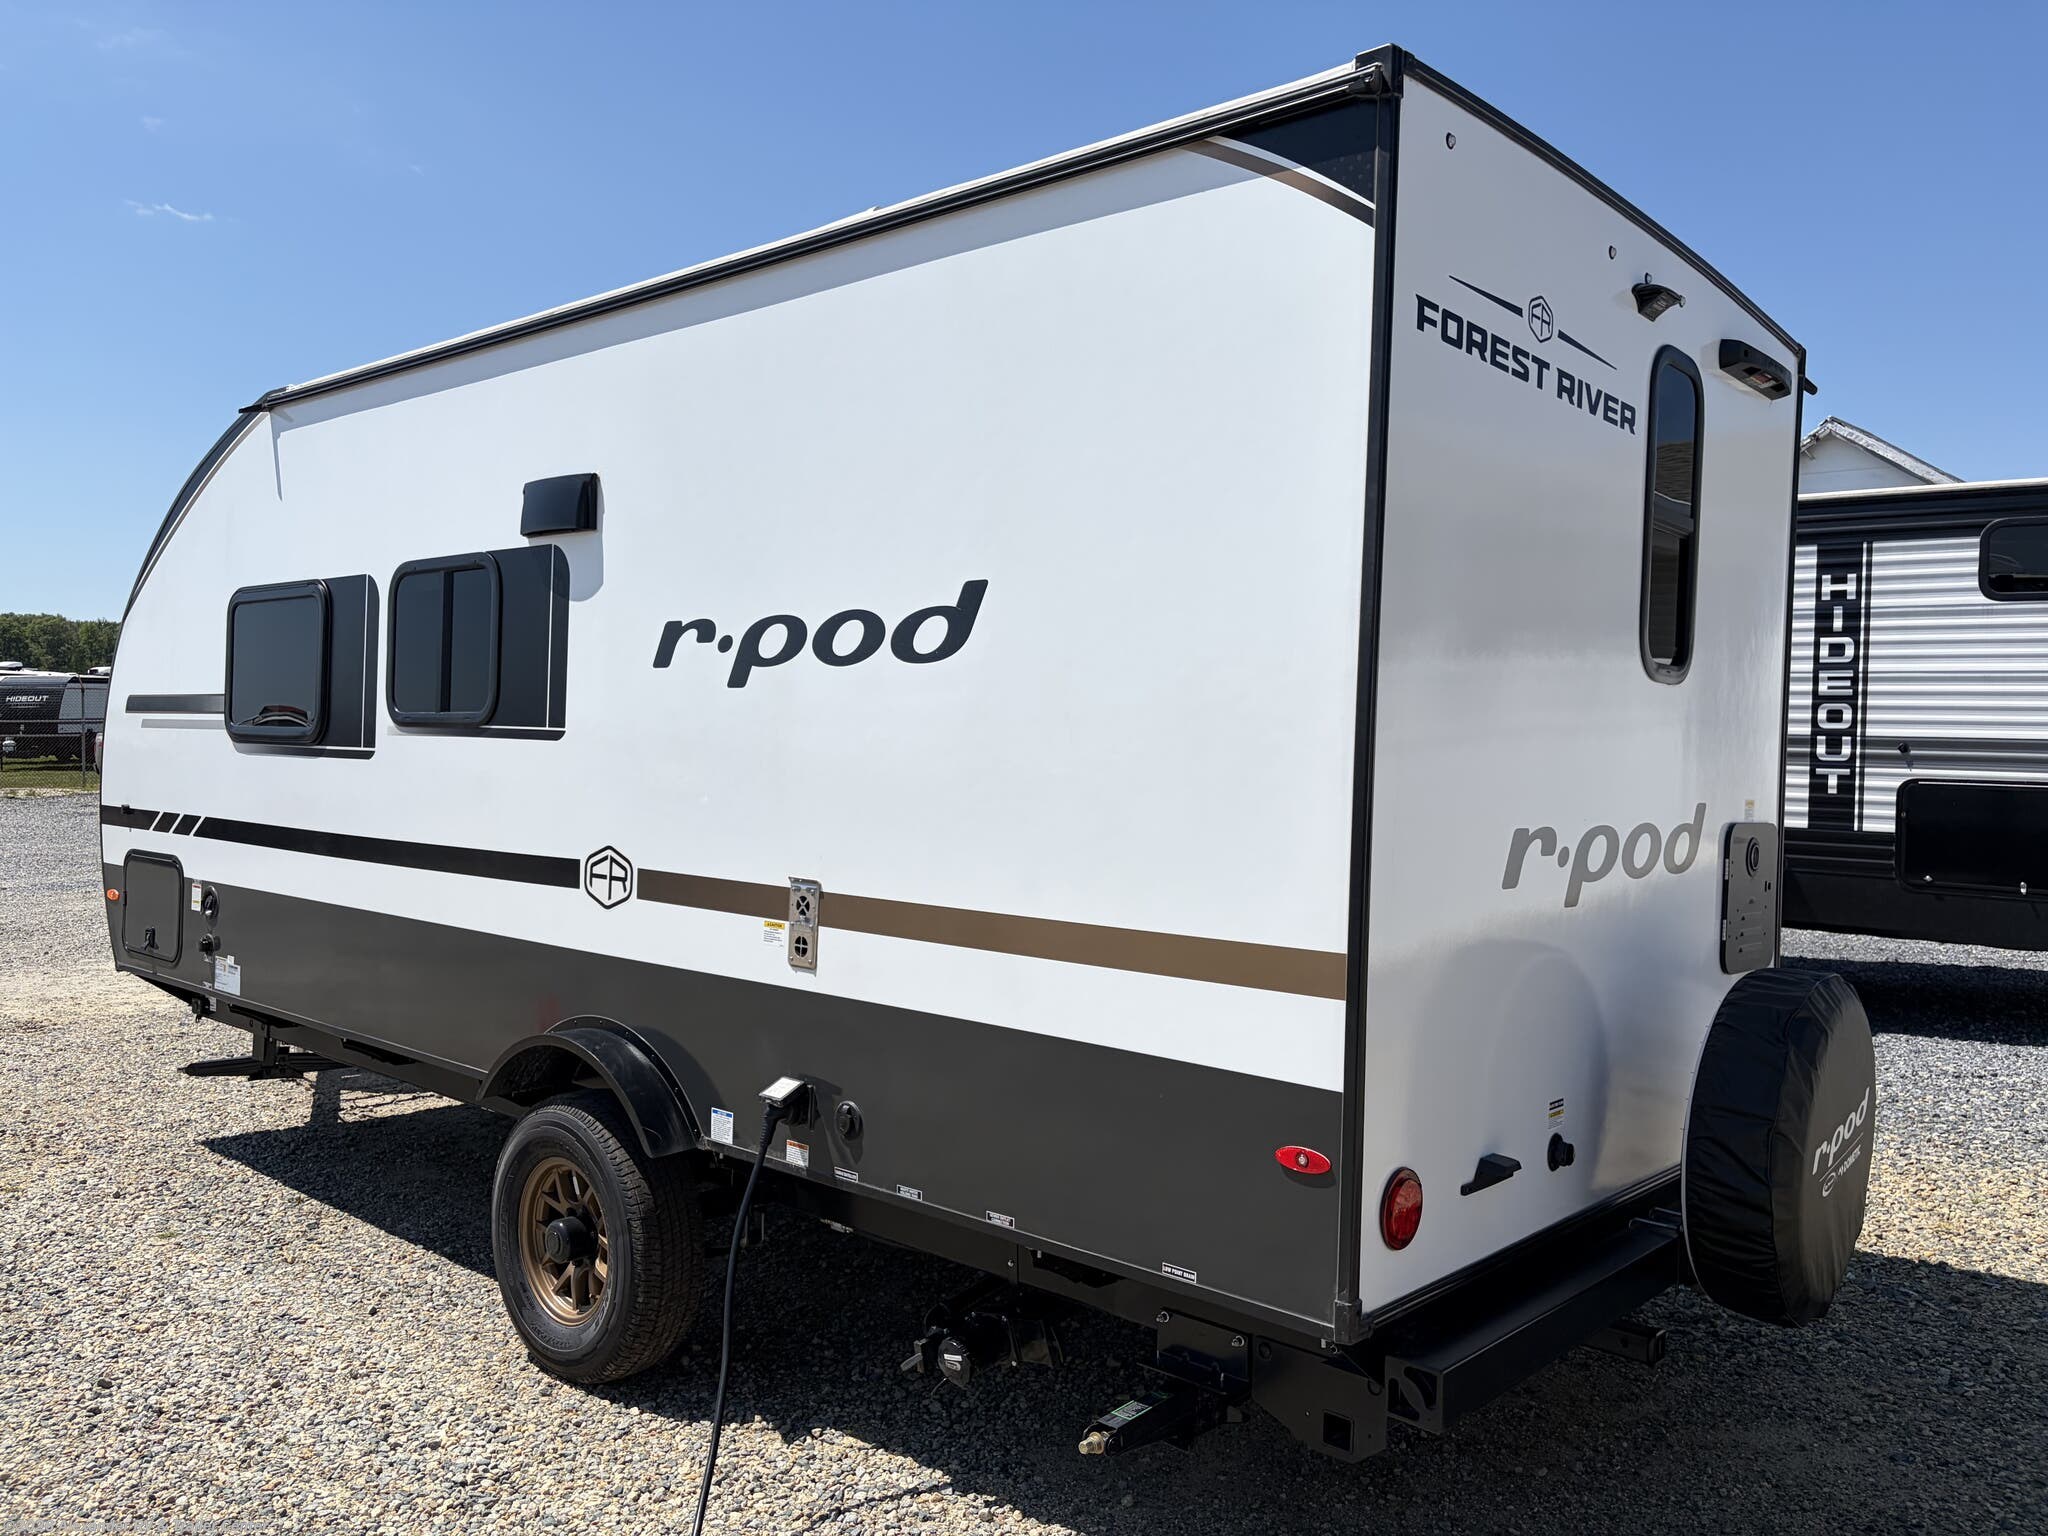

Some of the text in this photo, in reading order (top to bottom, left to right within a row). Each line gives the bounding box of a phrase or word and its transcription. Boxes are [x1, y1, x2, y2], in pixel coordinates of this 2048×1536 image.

[1415, 294, 1636, 435] FOREST RIVER
[1816, 573, 1857, 794] HIDEOUT
